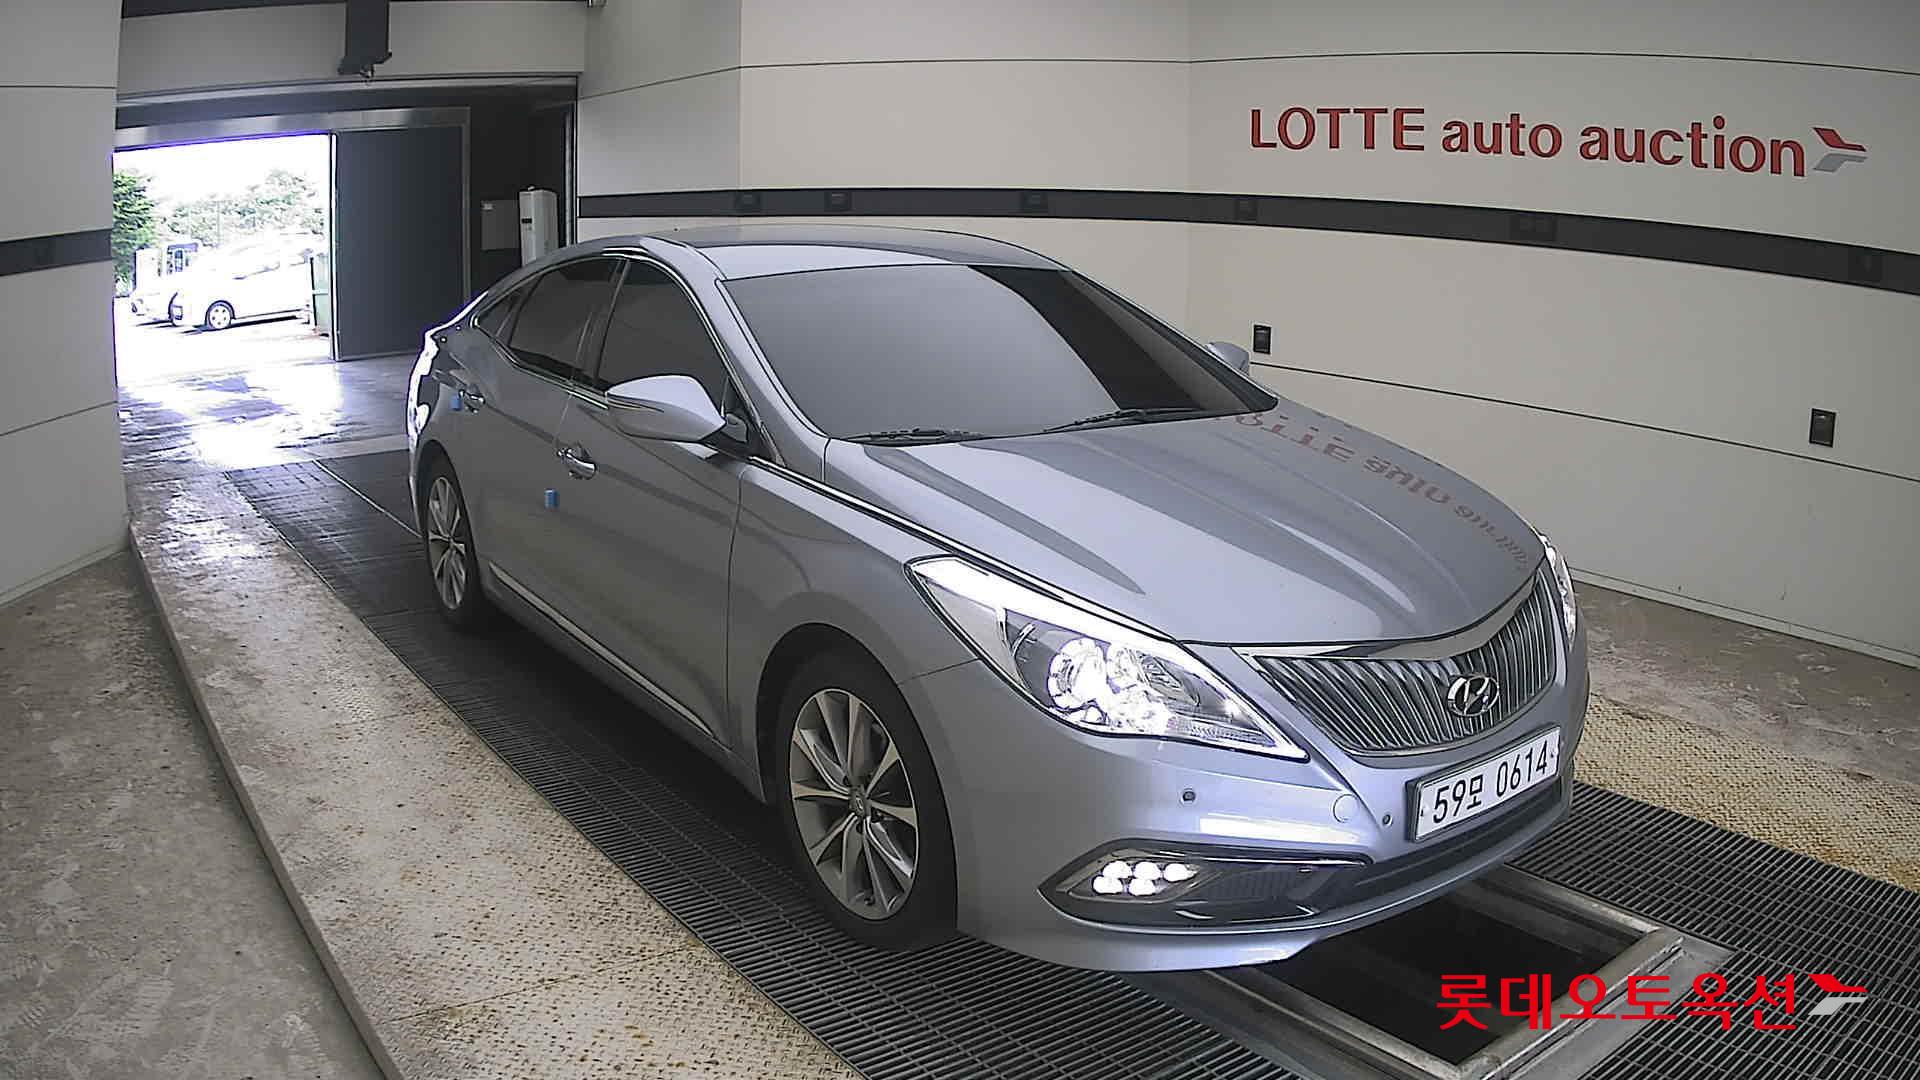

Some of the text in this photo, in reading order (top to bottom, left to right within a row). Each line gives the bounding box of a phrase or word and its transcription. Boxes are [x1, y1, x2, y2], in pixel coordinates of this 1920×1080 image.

[1250, 106, 1806, 177] LOTTE auto auction
[1432, 740, 1548, 824] 59모 0614
